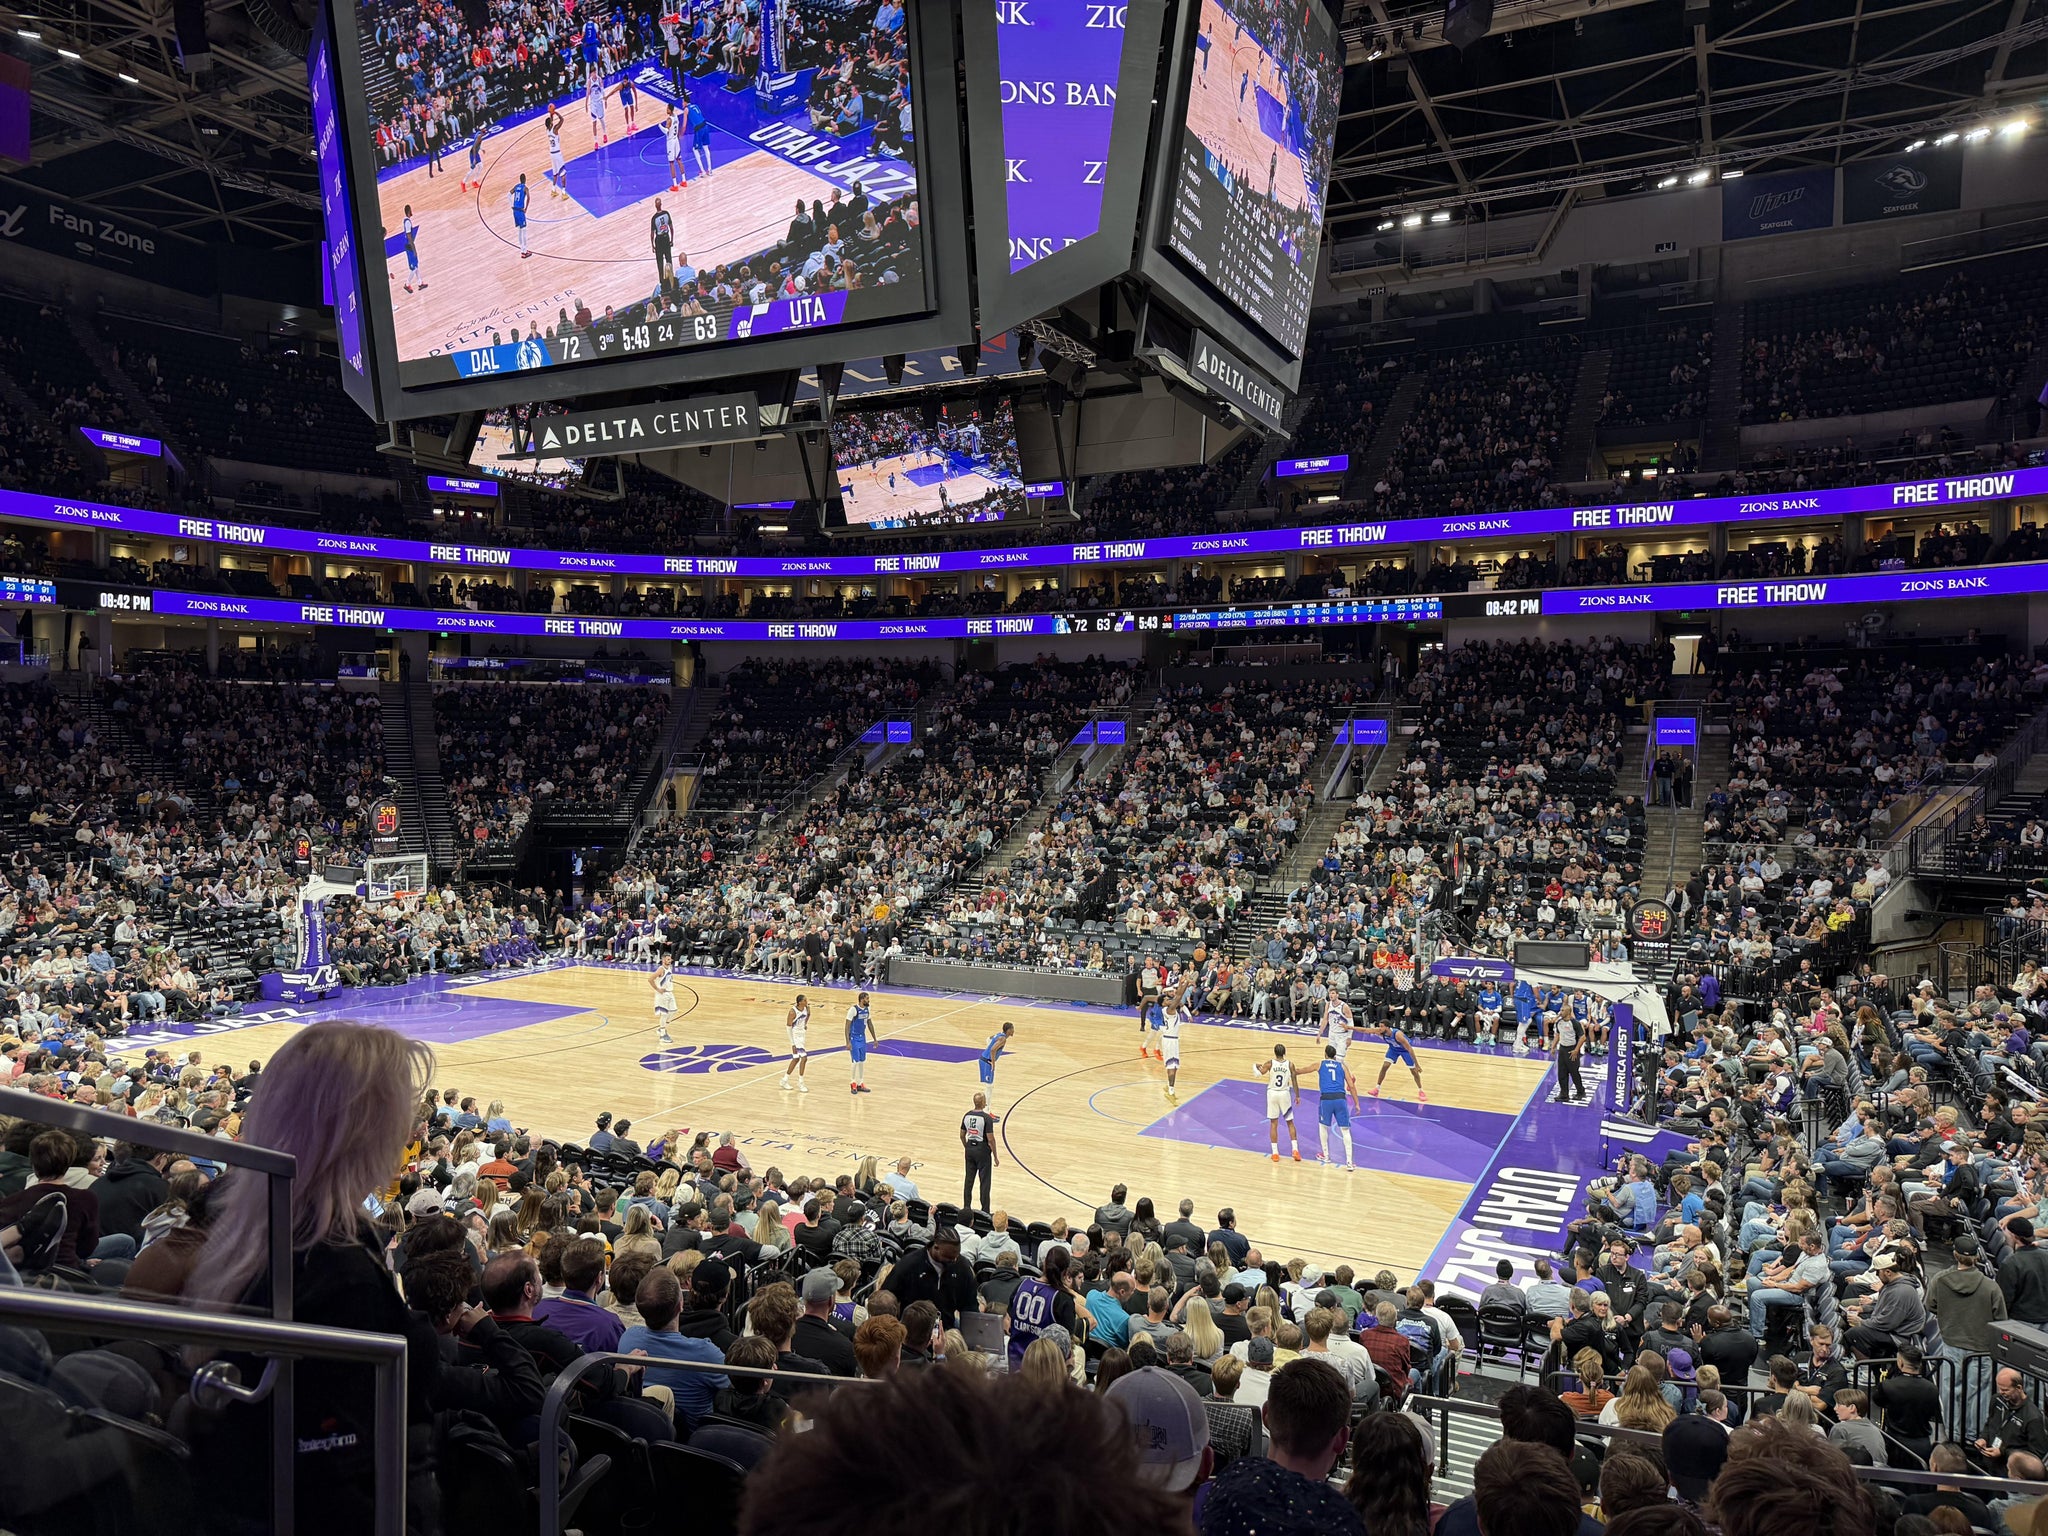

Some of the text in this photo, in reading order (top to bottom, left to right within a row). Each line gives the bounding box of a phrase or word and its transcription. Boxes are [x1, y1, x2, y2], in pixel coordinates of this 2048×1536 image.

[749, 121, 841, 164] UTAH
[1237, 186, 1244, 204] 72
[1750, 187, 1804, 219] UTAH
[1883, 202, 1919, 214] SEATGEEK
[50, 205, 155, 254] Fan Zone
[1760, 219, 1793, 230] SEATGEEK
[1369, 287, 1385, 295] HH
[789, 297, 826, 325] UTA
[428, 325, 495, 358] DELTA
[502, 289, 576, 324] CENTER
[694, 314, 717, 340] 63
[623, 325, 650, 351] 5:43
[658, 325, 673, 342] 24
[560, 336, 580, 359] 72
[600, 333, 614, 351] 3RD
[471, 347, 500, 373] DAL
[1210, 354, 1281, 420] DELTA CENTER
[565, 405, 748, 445] DELTA CENTER
[102, 434, 117, 442] FREE
[117, 437, 140, 448] THROW
[1037, 484, 1053, 492] THROW
[1894, 475, 2014, 504] FREE THROW
[55, 505, 88, 517] ZIONS
[1740, 502, 1778, 512] ZIONS
[908, 519, 917, 527] 72
[1573, 505, 1673, 527] FREE THROW
[180, 519, 264, 543] FREE THROW
[1443, 522, 1476, 532] ZIONS
[1301, 525, 1386, 545] FREE THROW
[318, 539, 347, 548] ZIONS
[1192, 541, 1219, 549] ZIONS
[430, 546, 510, 564] FREE THROW
[981, 555, 1004, 563] ZIONS
[1073, 543, 1145, 560] FREE THROW
[560, 557, 588, 565] ZIONS
[665, 559, 737, 572] FREE THROW
[875, 556, 940, 571] FREE THROW
[22, 584, 34, 592] 104
[41, 586, 50, 594] 91
[1901, 580, 1943, 591] ZIONS
[6, 592, 15, 600] 27
[39, 595, 51, 603] 104
[1580, 596, 1615, 605] ZIONS
[1718, 583, 1826, 604] FREE THROW
[100, 593, 150, 611] 08:42 PM
[187, 601, 217, 610] ZIONS
[1486, 599, 1539, 615] 08:42 PM
[302, 607, 384, 624] FREE THROW
[437, 618, 466, 626] ZIONS
[545, 620, 622, 635] FREE THROW
[769, 625, 837, 637] FREE THROW
[967, 619, 1033, 633] FREE THROW
[1074, 616, 1158, 632] 72 63 5:43
[380, 806, 396, 816] 5:43
[377, 815, 395, 832] 24
[298, 848, 308, 856] 24
[1643, 910, 1666, 921] 5:43
[1641, 921, 1662, 934] 24
[304, 984, 325, 992] AMERICA
[194, 1007, 318, 1034] JAZZ
[1224, 1019, 1320, 1035] PACS
[1615, 1027, 1628, 1107] AMERICA FIRST
[1275, 1075, 1283, 1087] 3
[1328, 1069, 1336, 1081] 7
[970, 1118, 977, 1128] 12
[1472, 1167, 1581, 1234] UTAH
[1016, 1291, 1045, 1324] 00
